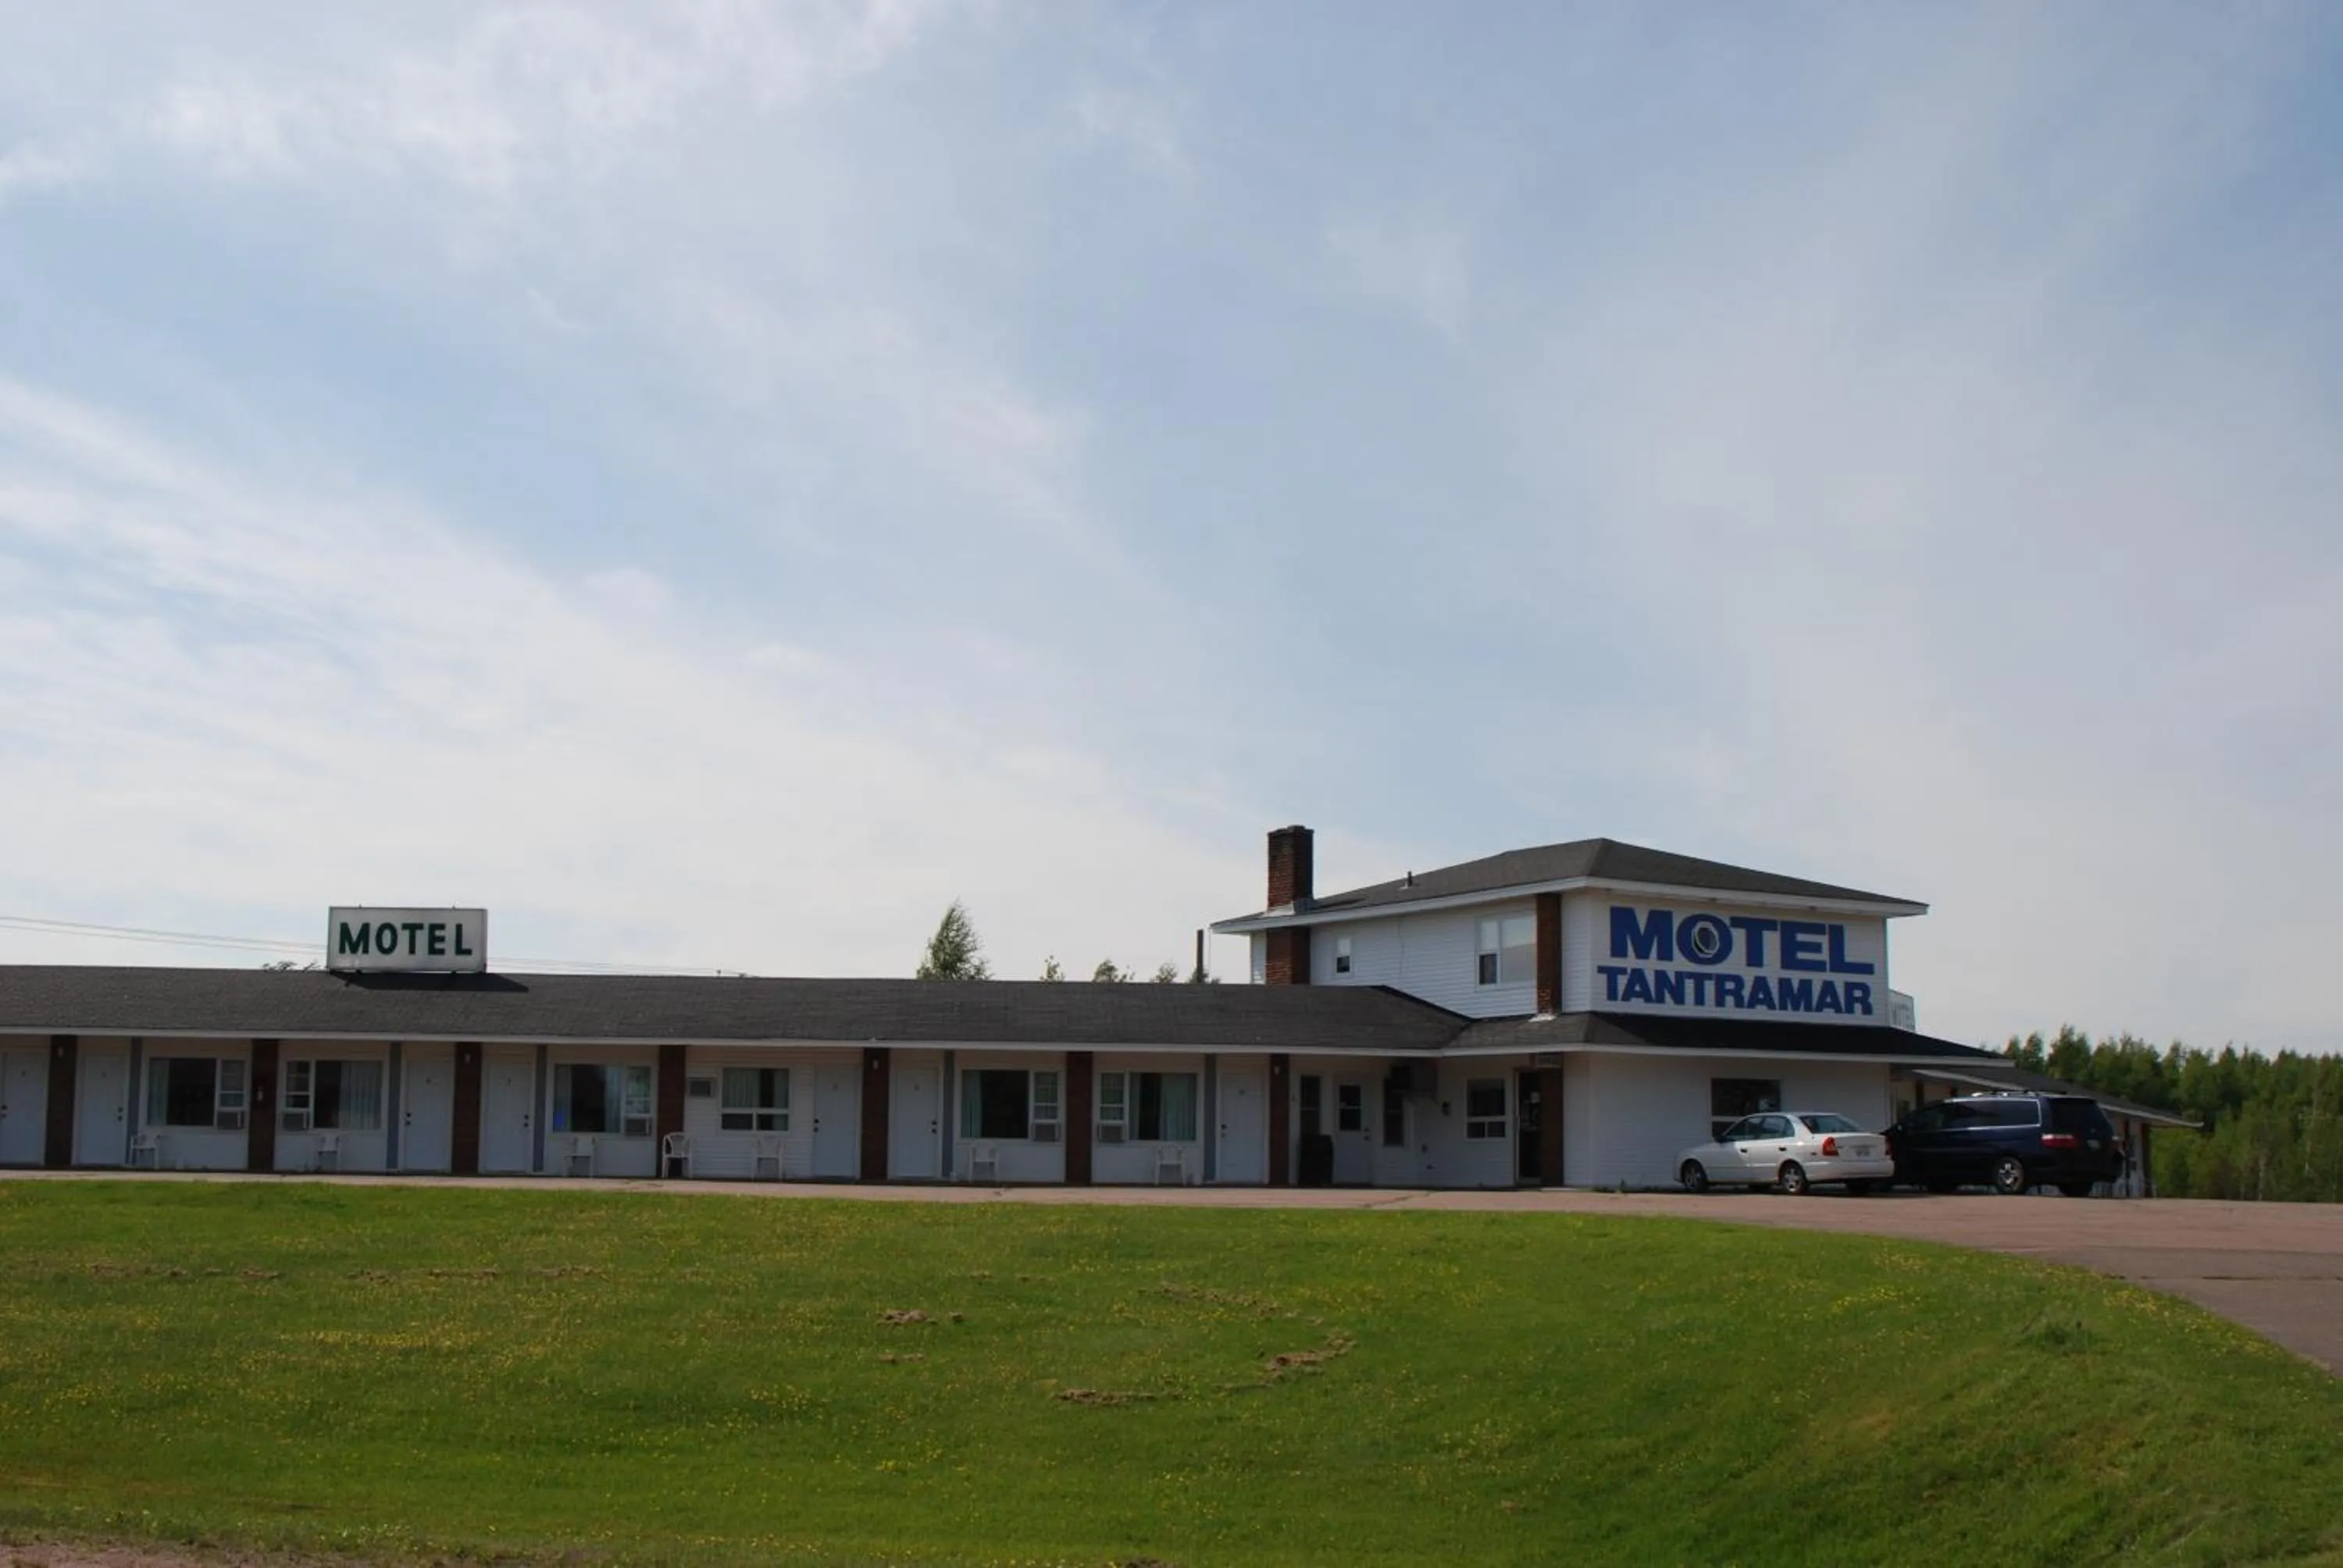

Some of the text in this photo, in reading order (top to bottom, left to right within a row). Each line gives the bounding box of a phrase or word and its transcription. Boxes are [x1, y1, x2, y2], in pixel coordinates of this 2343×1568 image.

[339, 922, 473, 956] MOTEL
[1610, 906, 1874, 975] MOTEL
[1597, 965, 1873, 1015] TANTRAMAR
